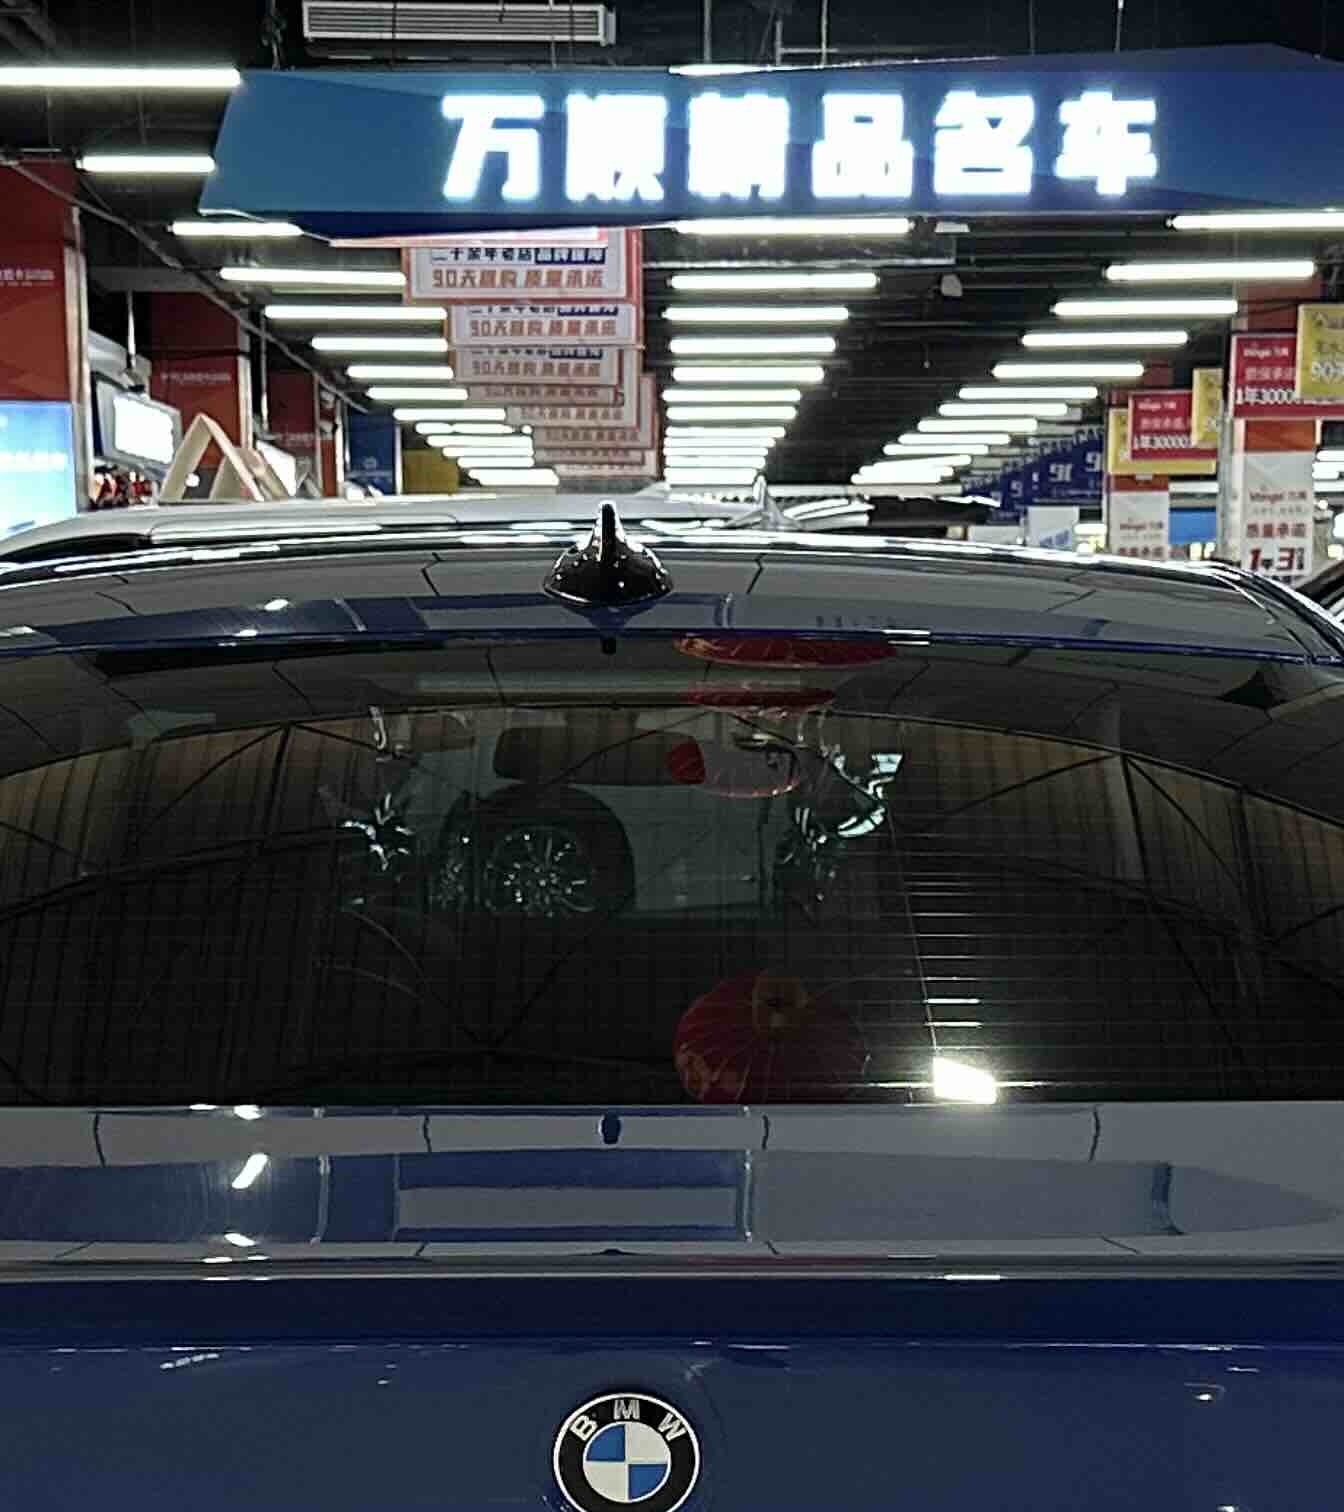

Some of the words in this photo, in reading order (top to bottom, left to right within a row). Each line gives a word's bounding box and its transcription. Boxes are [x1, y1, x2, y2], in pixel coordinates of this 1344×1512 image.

[442, 90, 1157, 201] 万顺精品名车
[568, 1398, 689, 1442] BMW
